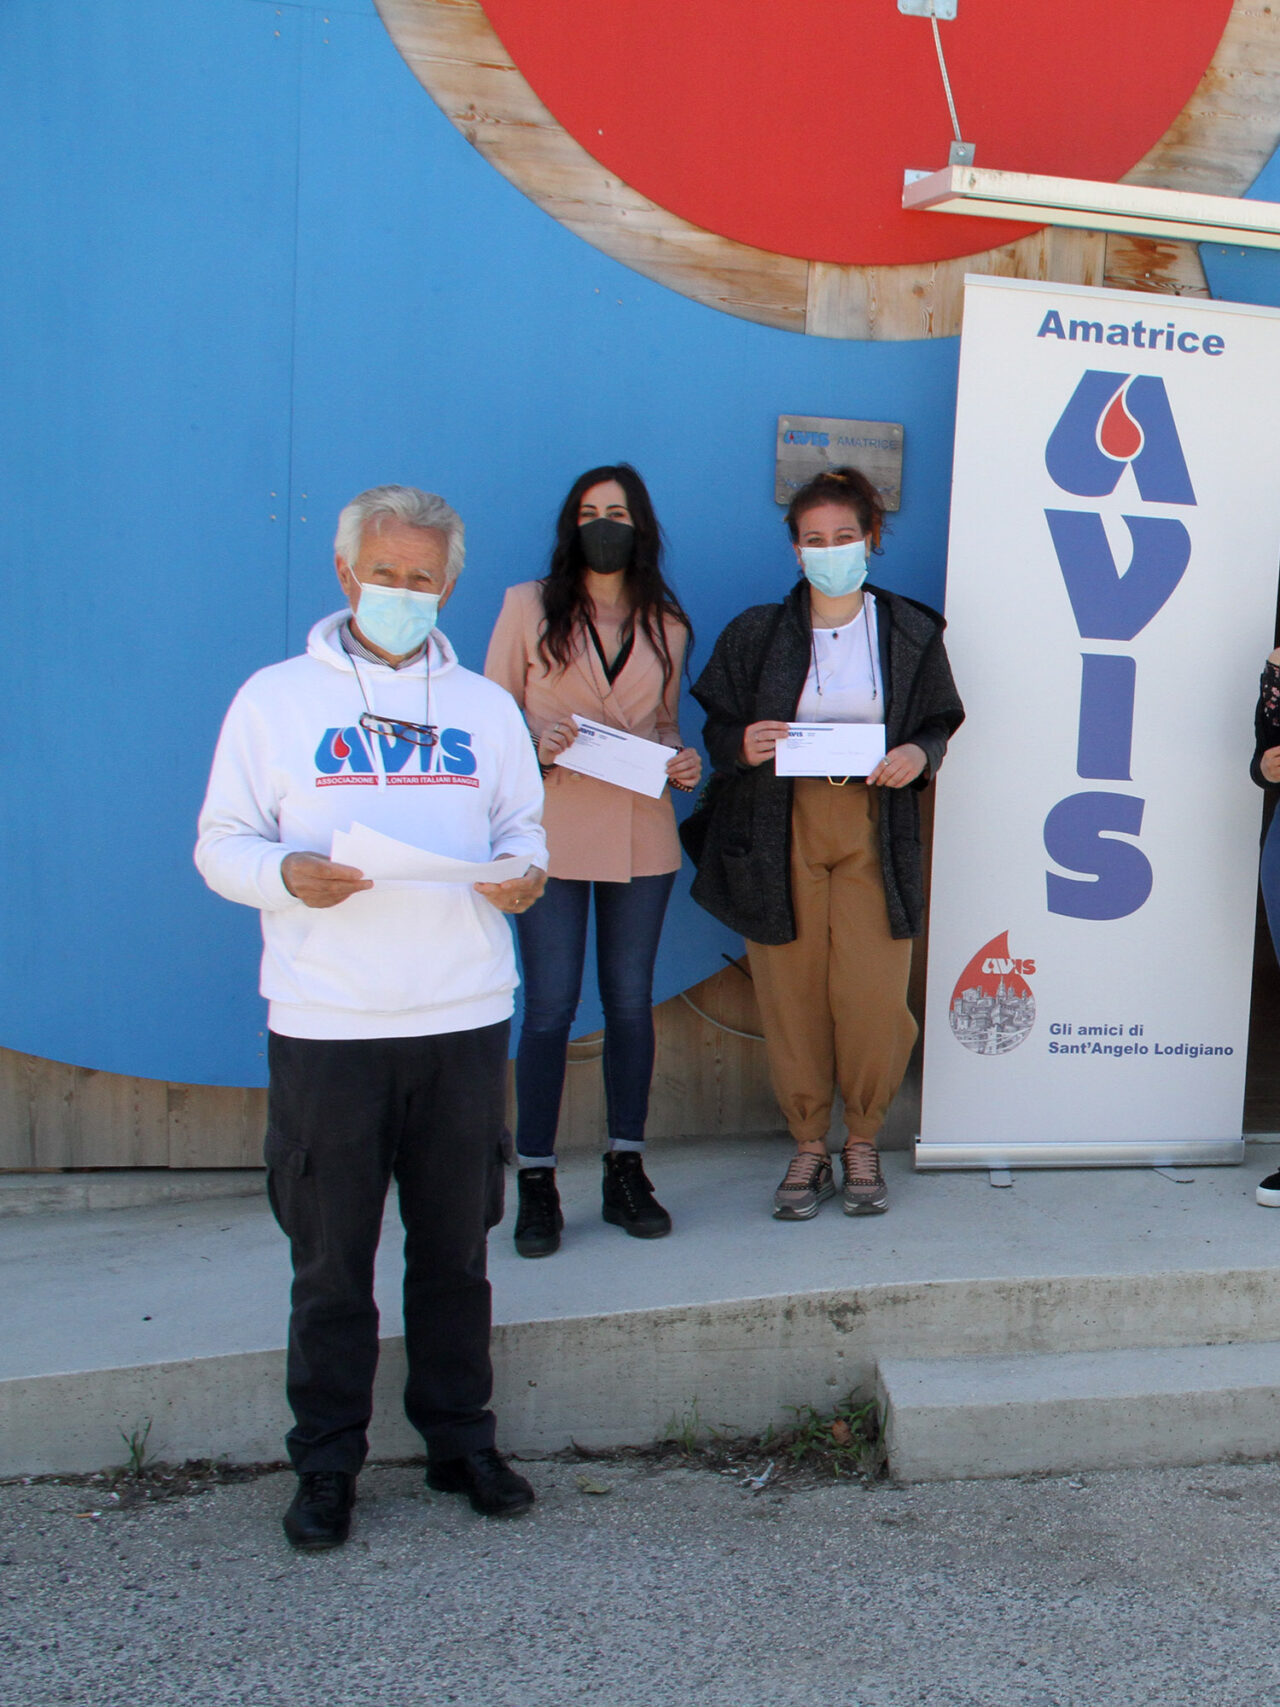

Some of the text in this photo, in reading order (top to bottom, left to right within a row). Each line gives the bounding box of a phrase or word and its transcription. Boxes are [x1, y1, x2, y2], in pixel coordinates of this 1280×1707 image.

[1037, 310, 1225, 356] Amatrice
[783, 430, 896, 450] AVIS AMATRICE
[1044, 369, 1198, 921] AVIS
[314, 725, 477, 775] AVIS
[317, 777, 374, 785] ASSOCIAZIONE
[452, 777, 478, 786] SANGUE
[982, 958, 1037, 976] AVIS
[1049, 1022, 1144, 1036] Gli amici di
[1154, 1042, 1234, 1058] Lodigiano
